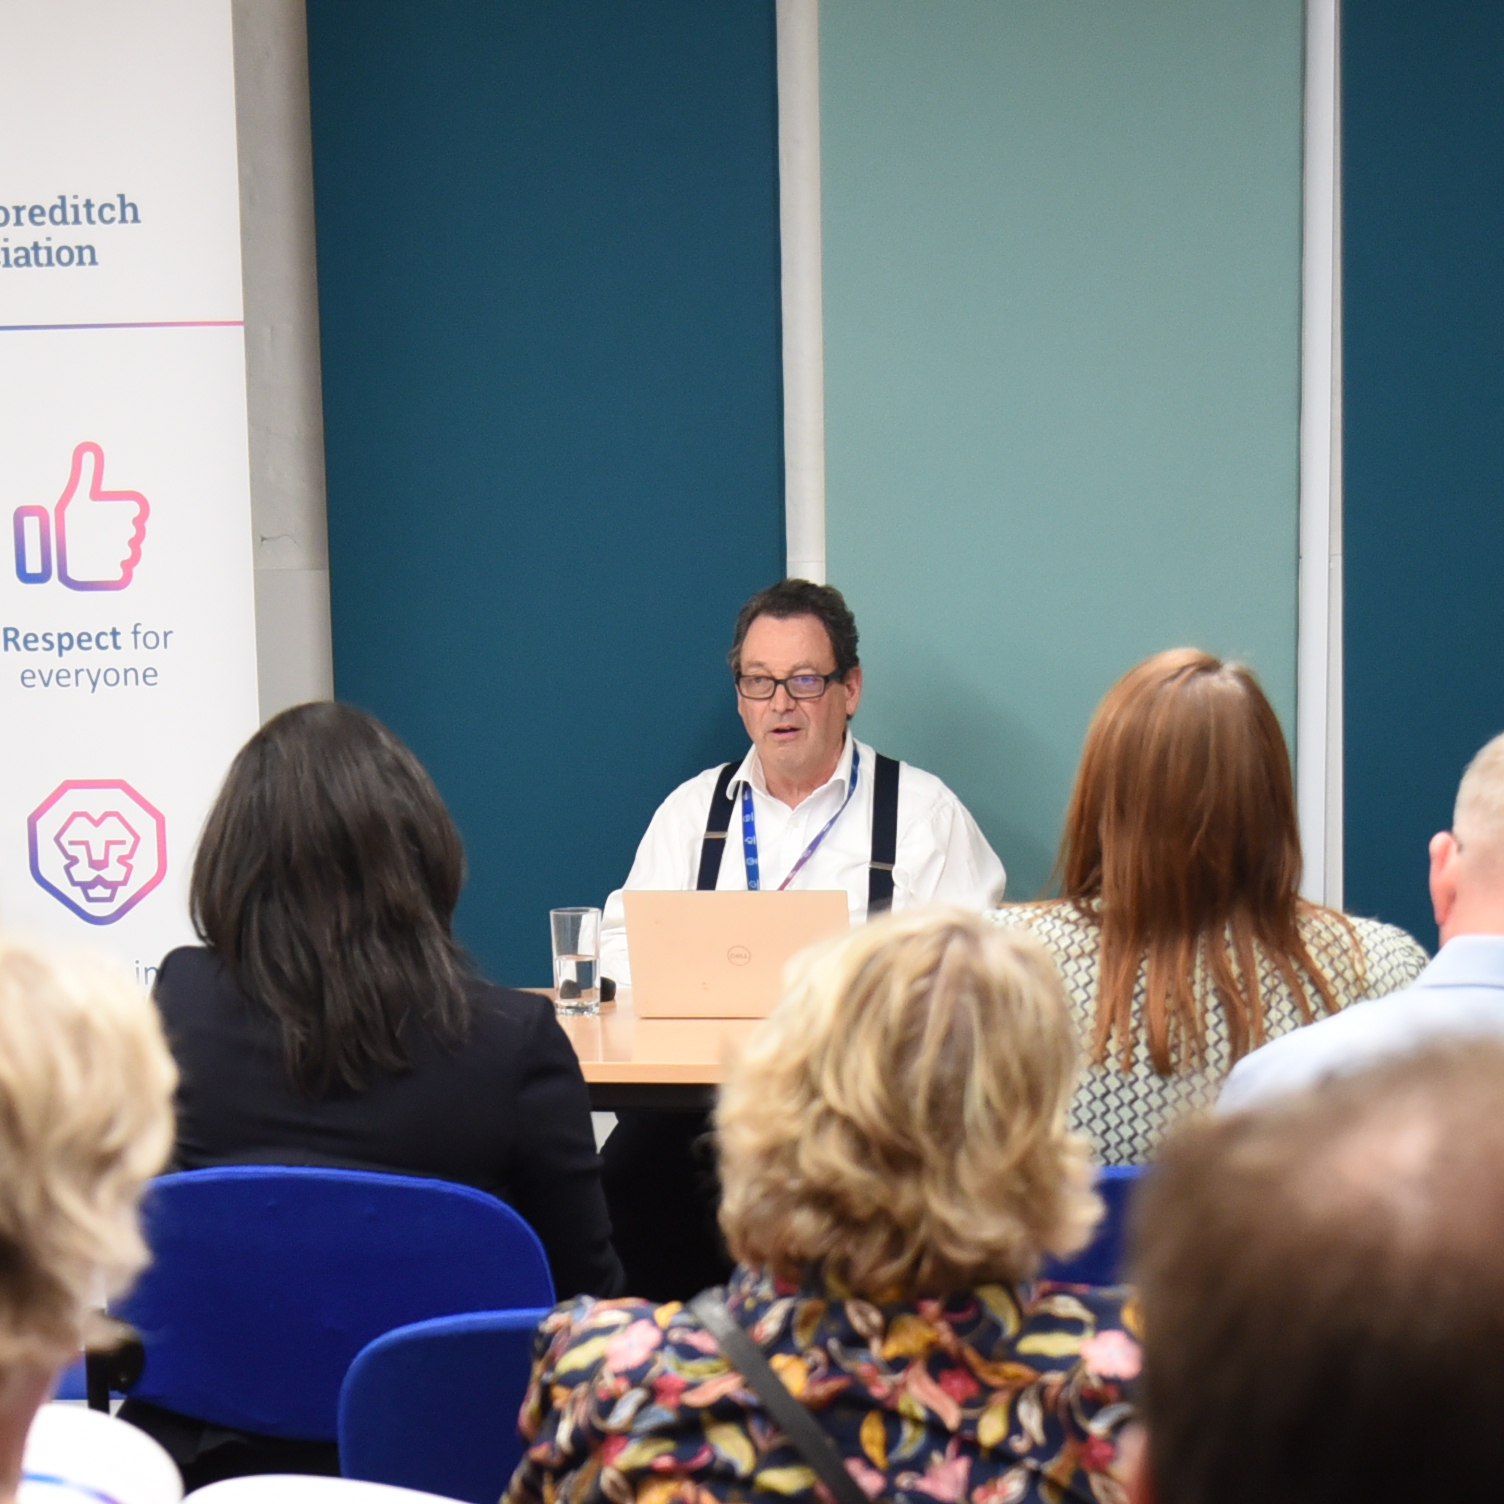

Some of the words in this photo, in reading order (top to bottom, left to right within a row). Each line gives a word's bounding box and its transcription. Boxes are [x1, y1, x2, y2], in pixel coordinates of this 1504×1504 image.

[2, 626, 122, 657] Respect
[130, 623, 174, 651] for
[20, 666, 159, 694] everyone
